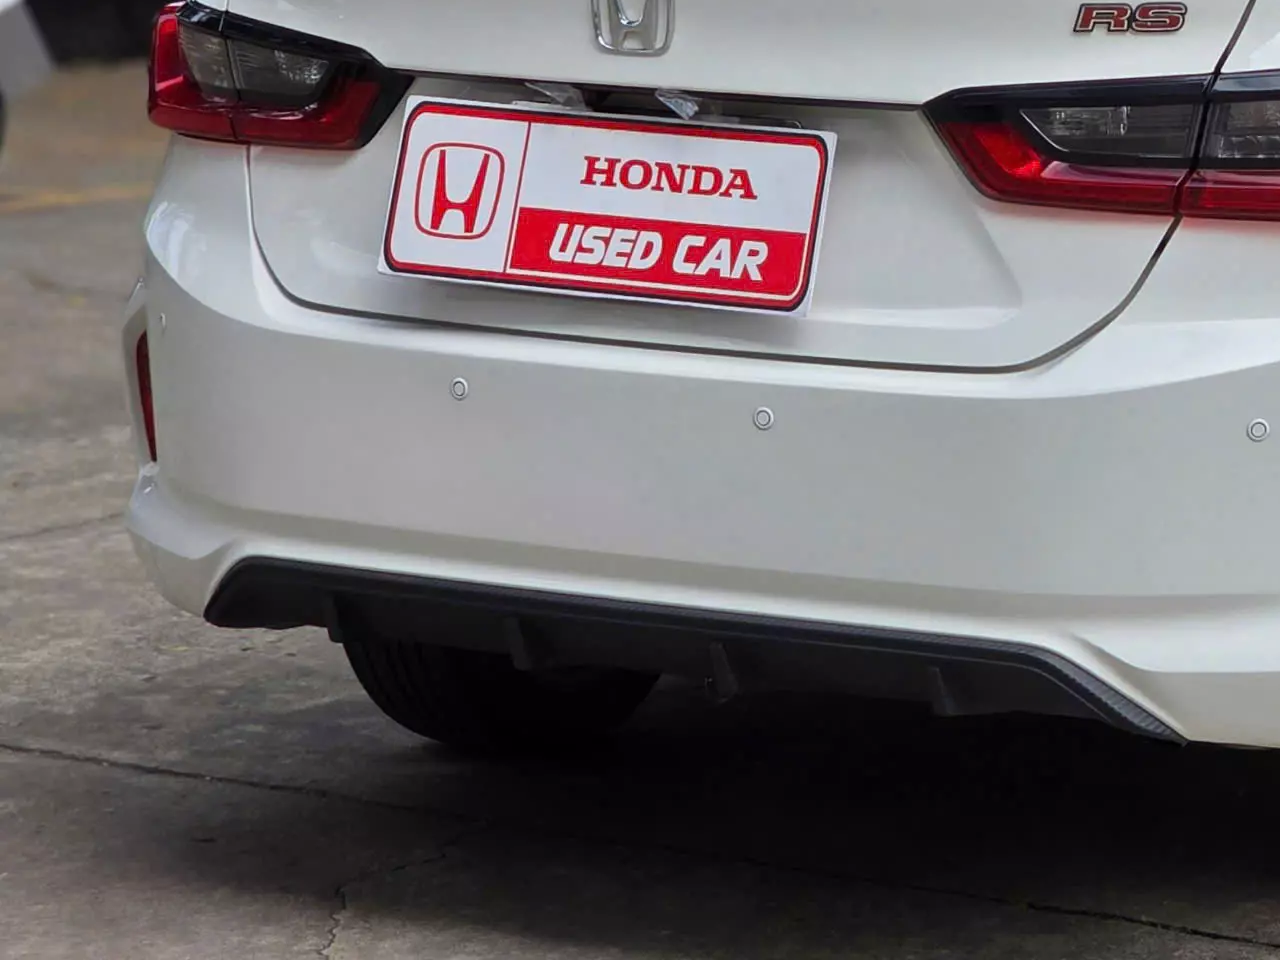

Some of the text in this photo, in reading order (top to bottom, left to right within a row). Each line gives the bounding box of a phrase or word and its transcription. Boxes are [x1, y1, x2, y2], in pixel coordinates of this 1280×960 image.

[1073, 2, 1188, 33] RS
[580, 156, 758, 200] HONDA
[549, 223, 769, 281] USED CAR
